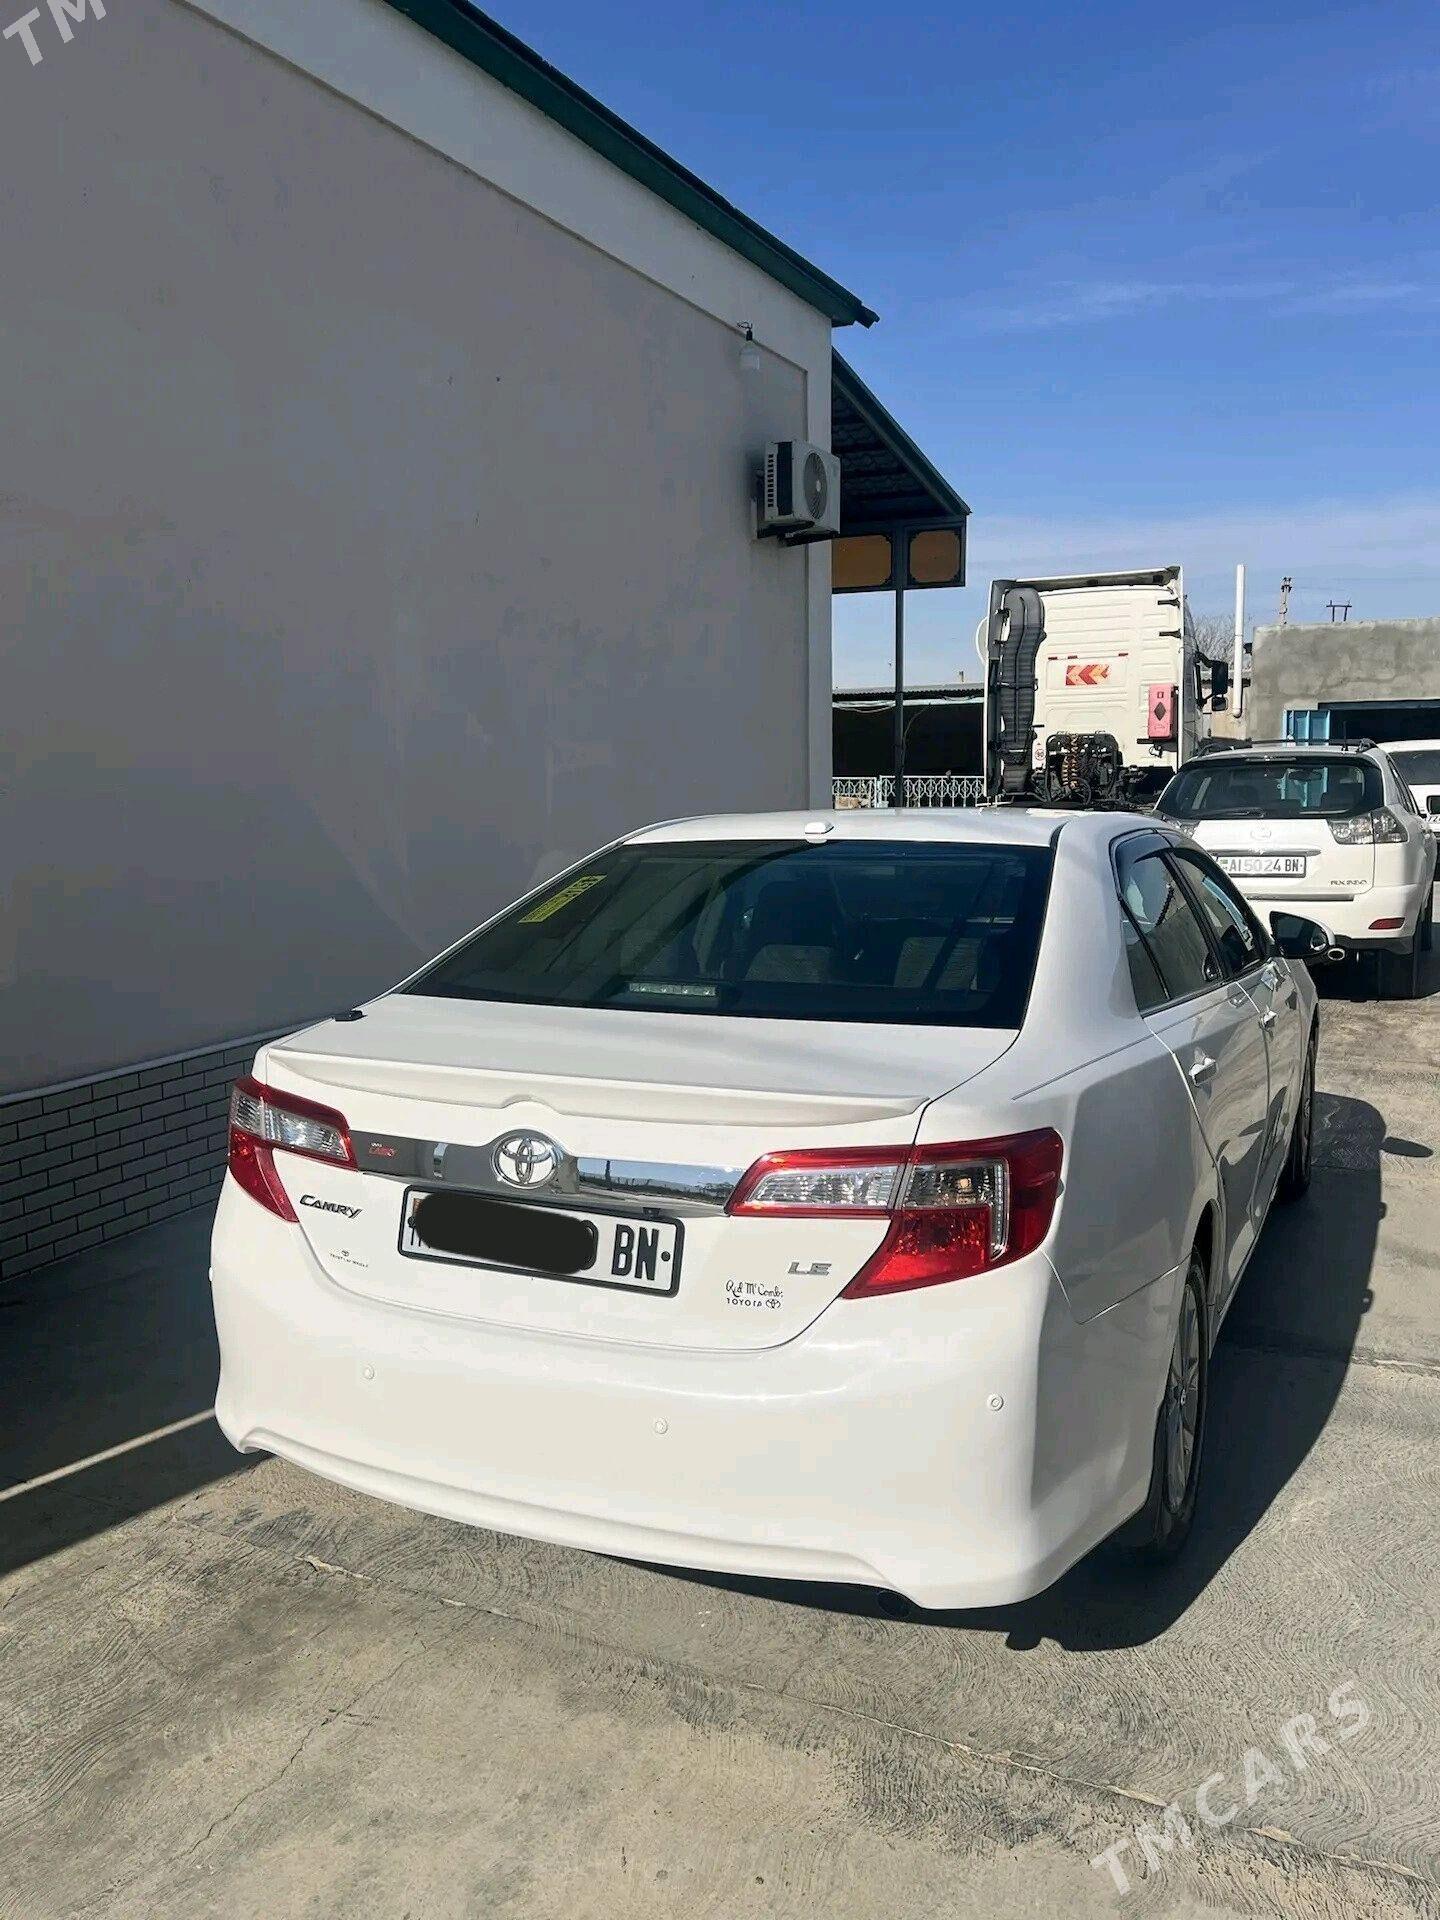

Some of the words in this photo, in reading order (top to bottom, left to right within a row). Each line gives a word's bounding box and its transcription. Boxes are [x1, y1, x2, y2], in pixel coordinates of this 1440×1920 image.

[1285, 859, 1299, 872] BN
[299, 1194, 363, 1219] CAMRY
[611, 1223, 660, 1281] BN
[788, 1261, 832, 1276] LE
[726, 1297, 763, 1308] TOYOTA
